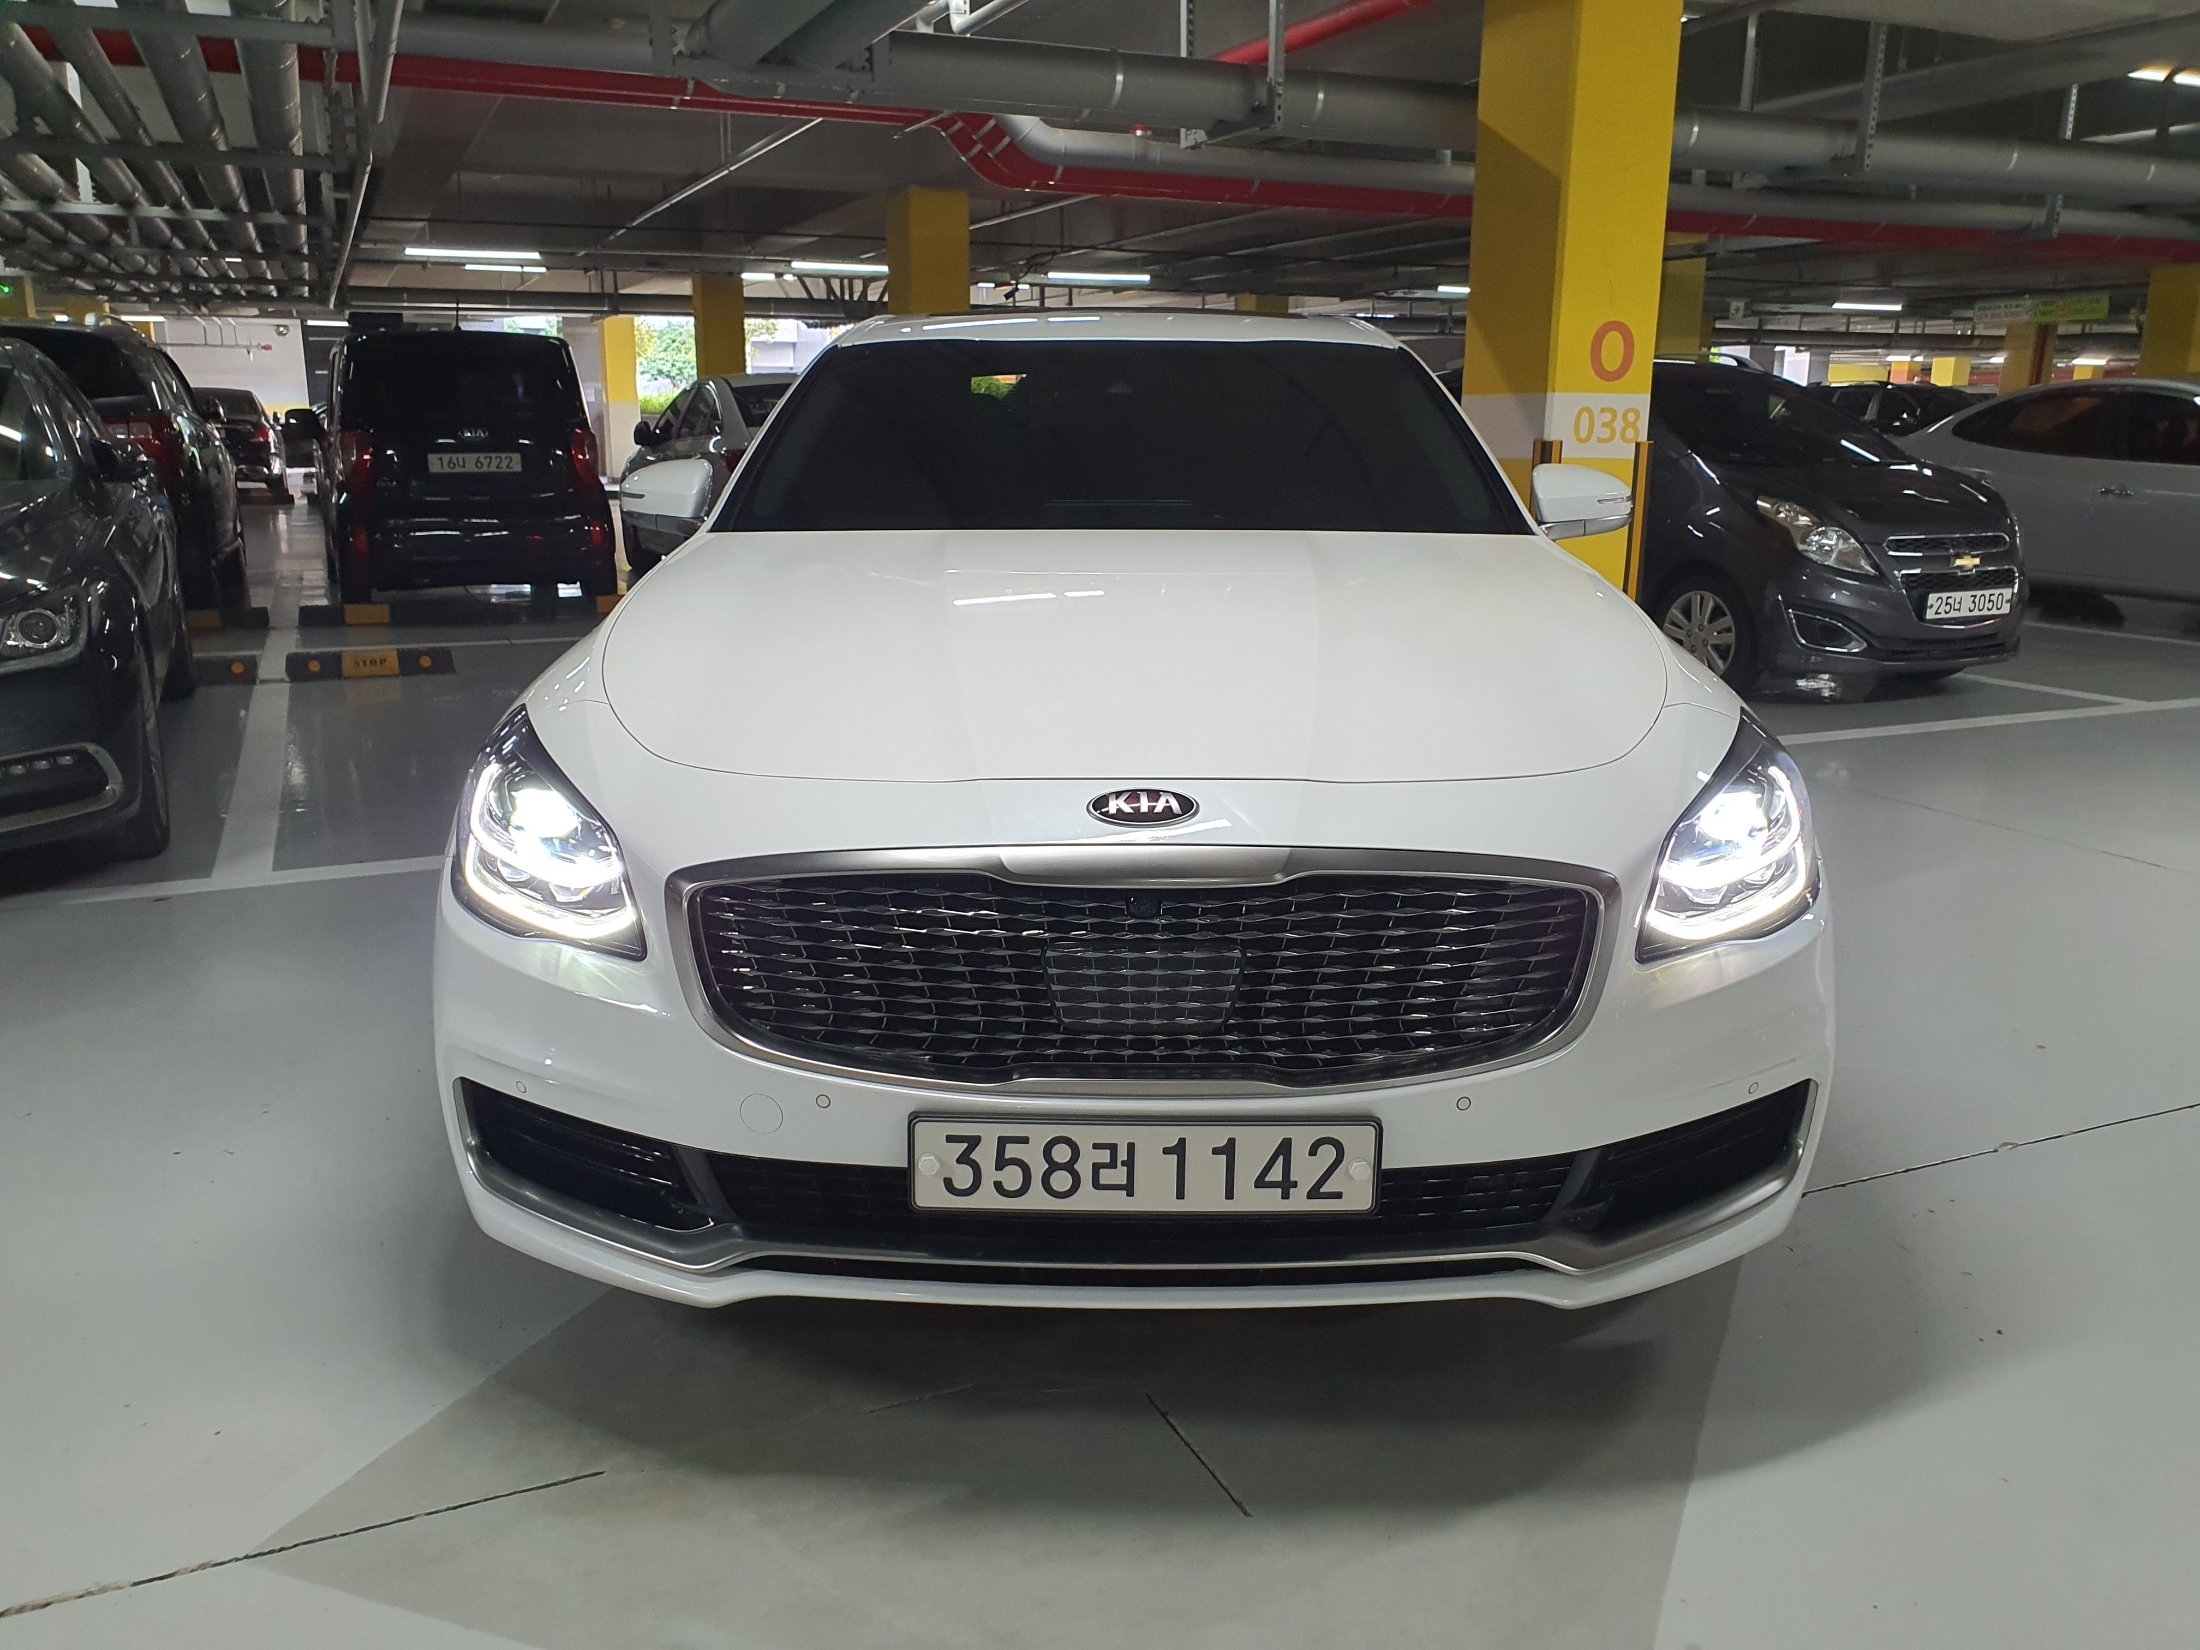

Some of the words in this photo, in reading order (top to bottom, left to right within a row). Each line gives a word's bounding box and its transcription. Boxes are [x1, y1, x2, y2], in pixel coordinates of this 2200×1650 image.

[1573, 406, 1641, 445] 038
[474, 456, 514, 470] 6722
[1934, 595, 1963, 615] 25너
[1968, 592, 2005, 613] 3050
[1106, 791, 1183, 815] KIA
[942, 1134, 1136, 1200] 358러
[1162, 1136, 1346, 1200] 1142
